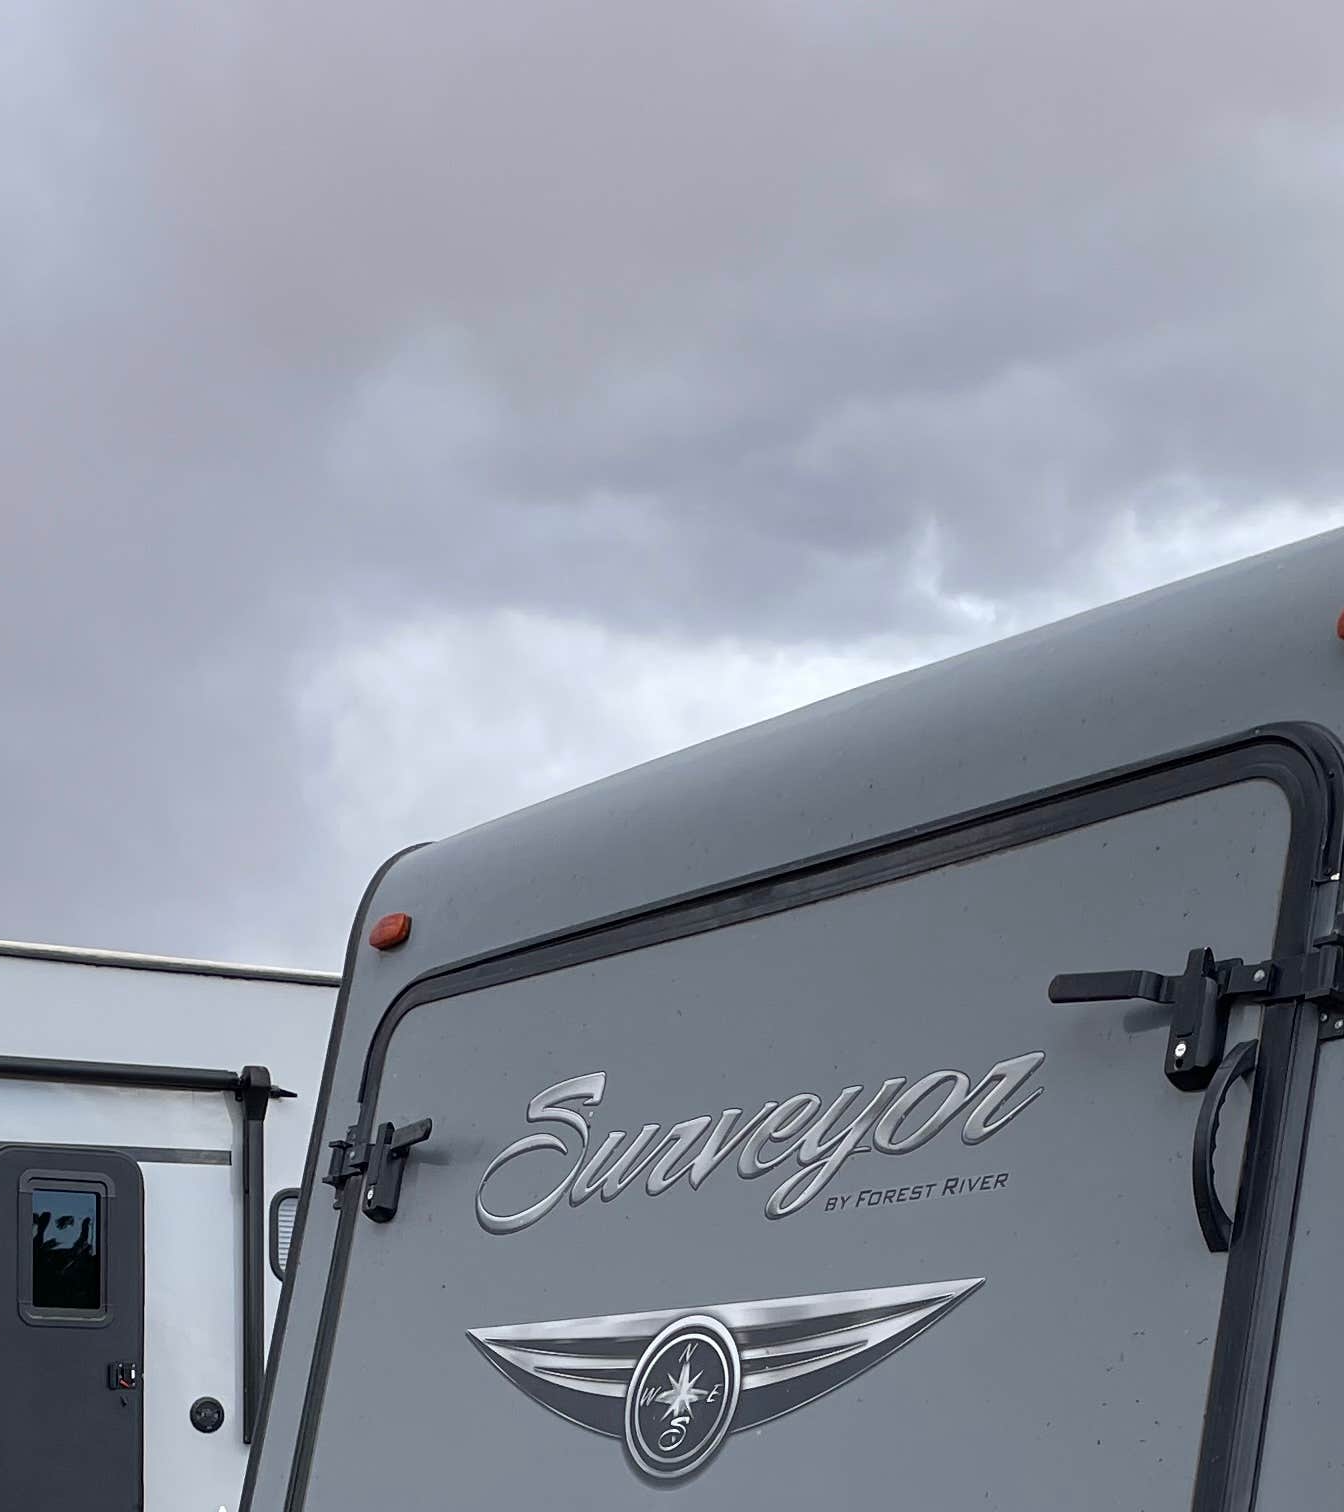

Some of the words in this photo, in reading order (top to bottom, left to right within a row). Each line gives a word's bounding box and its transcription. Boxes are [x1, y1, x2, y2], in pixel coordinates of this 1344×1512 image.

[475, 1050, 1046, 1235] Surveyor
[678, 1343, 699, 1363] N
[639, 1386, 662, 1407] W
[706, 1383, 724, 1403] E
[658, 1416, 691, 1451] S
